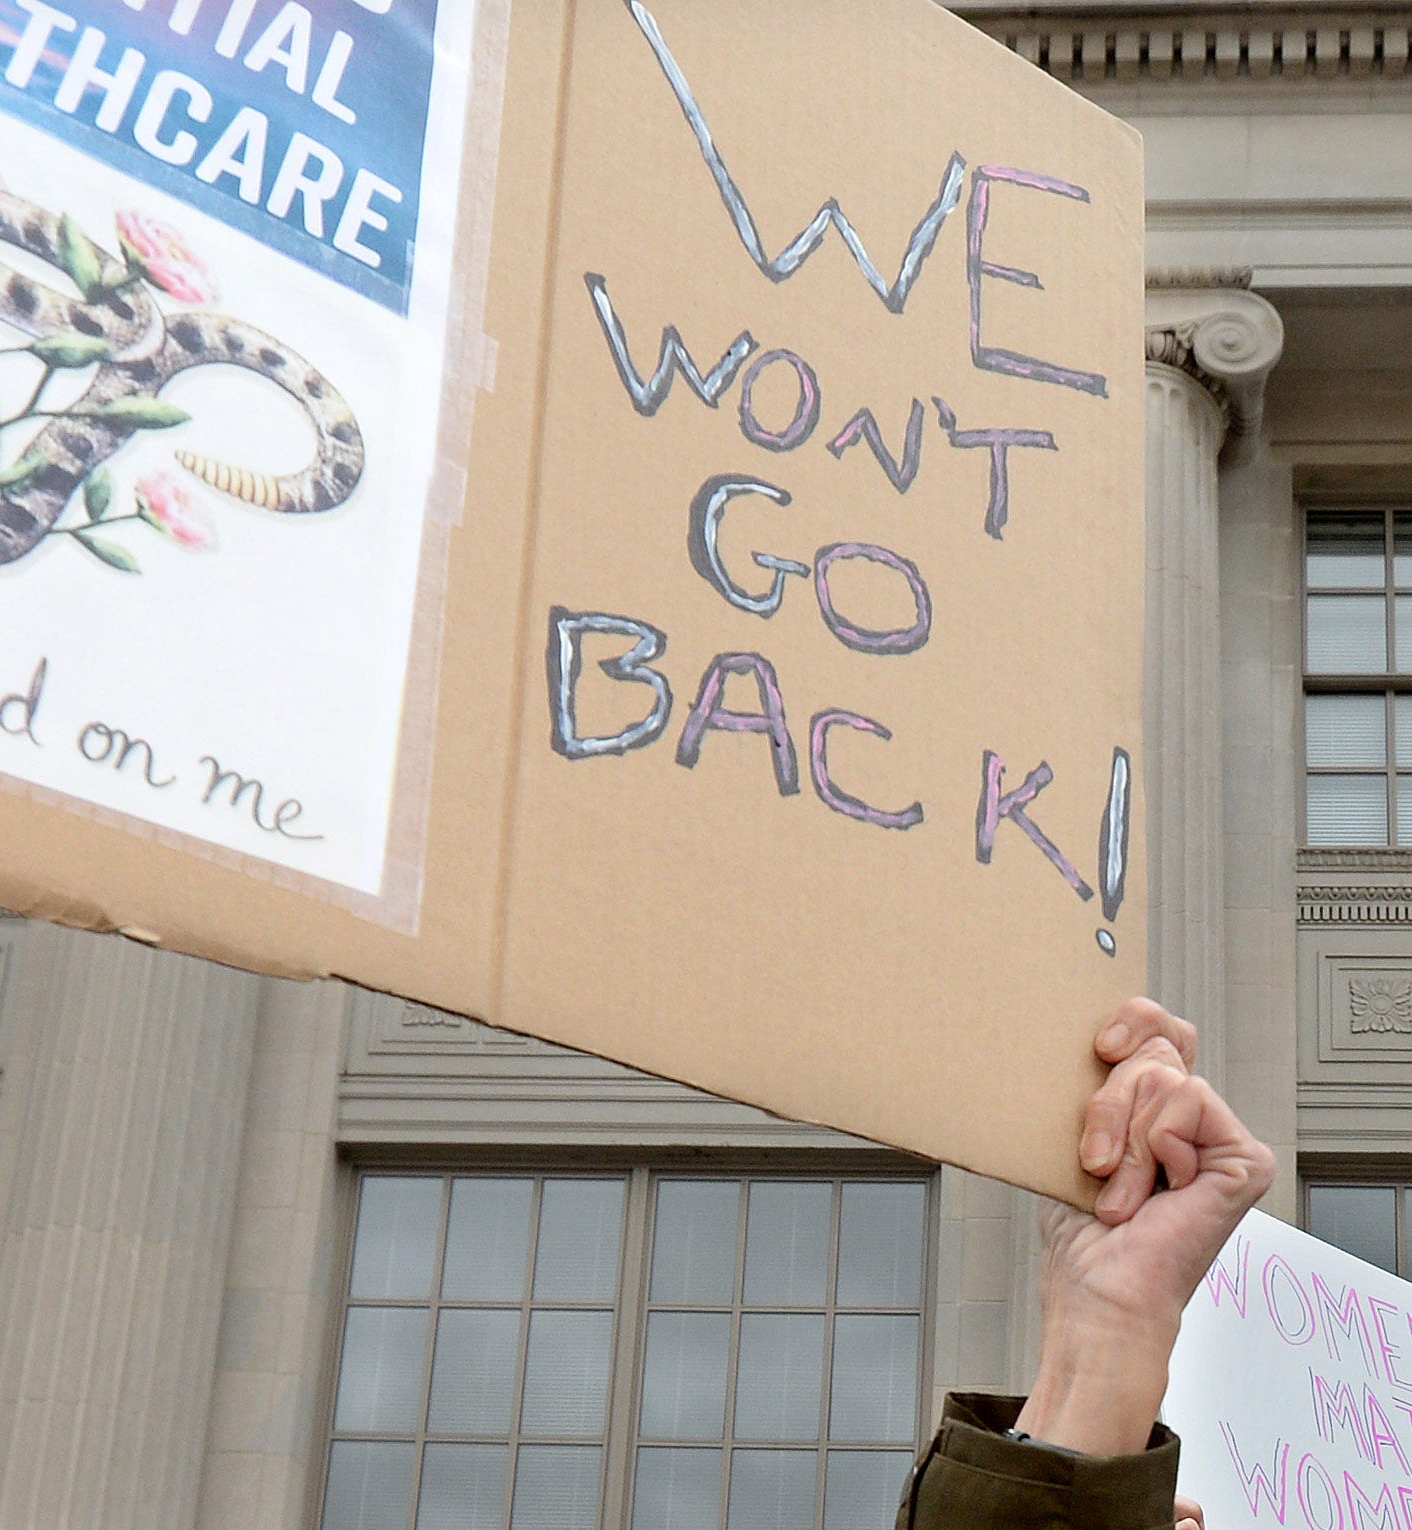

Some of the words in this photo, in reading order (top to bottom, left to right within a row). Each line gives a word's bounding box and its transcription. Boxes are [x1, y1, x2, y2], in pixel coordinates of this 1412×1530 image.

[122, 0, 357, 125] IAL
[624, 0, 1110, 398] WE
[583, 272, 1059, 540] WON'T
[688, 473, 933, 654] GO
[77, 721, 177, 788] on
[198, 754, 325, 841] me
[546, 605, 1133, 957] BACK!
